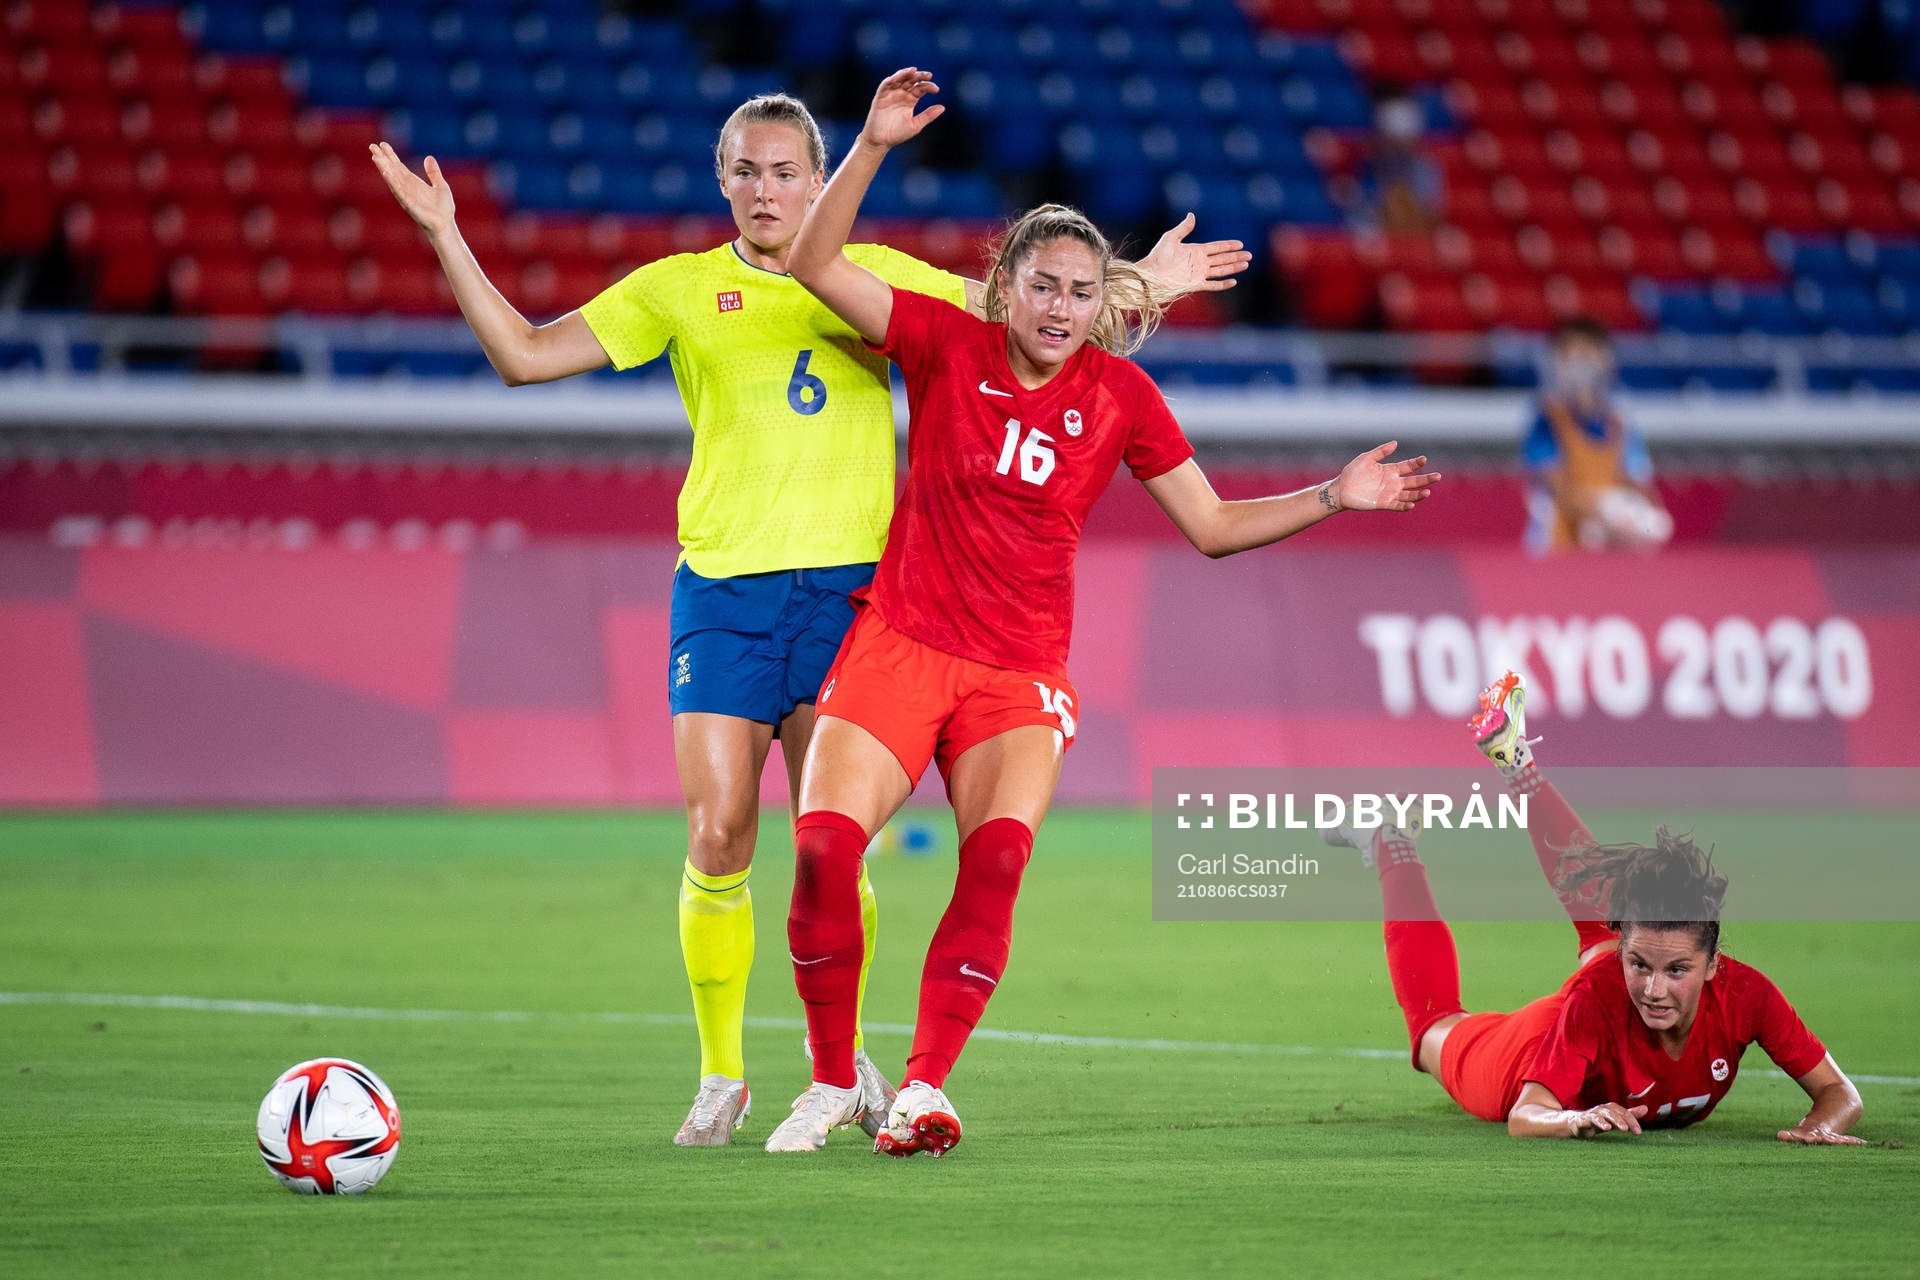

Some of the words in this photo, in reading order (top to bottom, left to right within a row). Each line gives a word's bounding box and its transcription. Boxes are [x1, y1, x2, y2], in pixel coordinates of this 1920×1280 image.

[720, 293, 738, 302] UNI
[720, 301, 740, 311] QLO
[787, 349, 827, 415] 6
[995, 418, 1056, 486] 16
[675, 673, 692, 688] SWE
[1361, 613, 1652, 718] TOKYO
[1657, 614, 1873, 718] 2020
